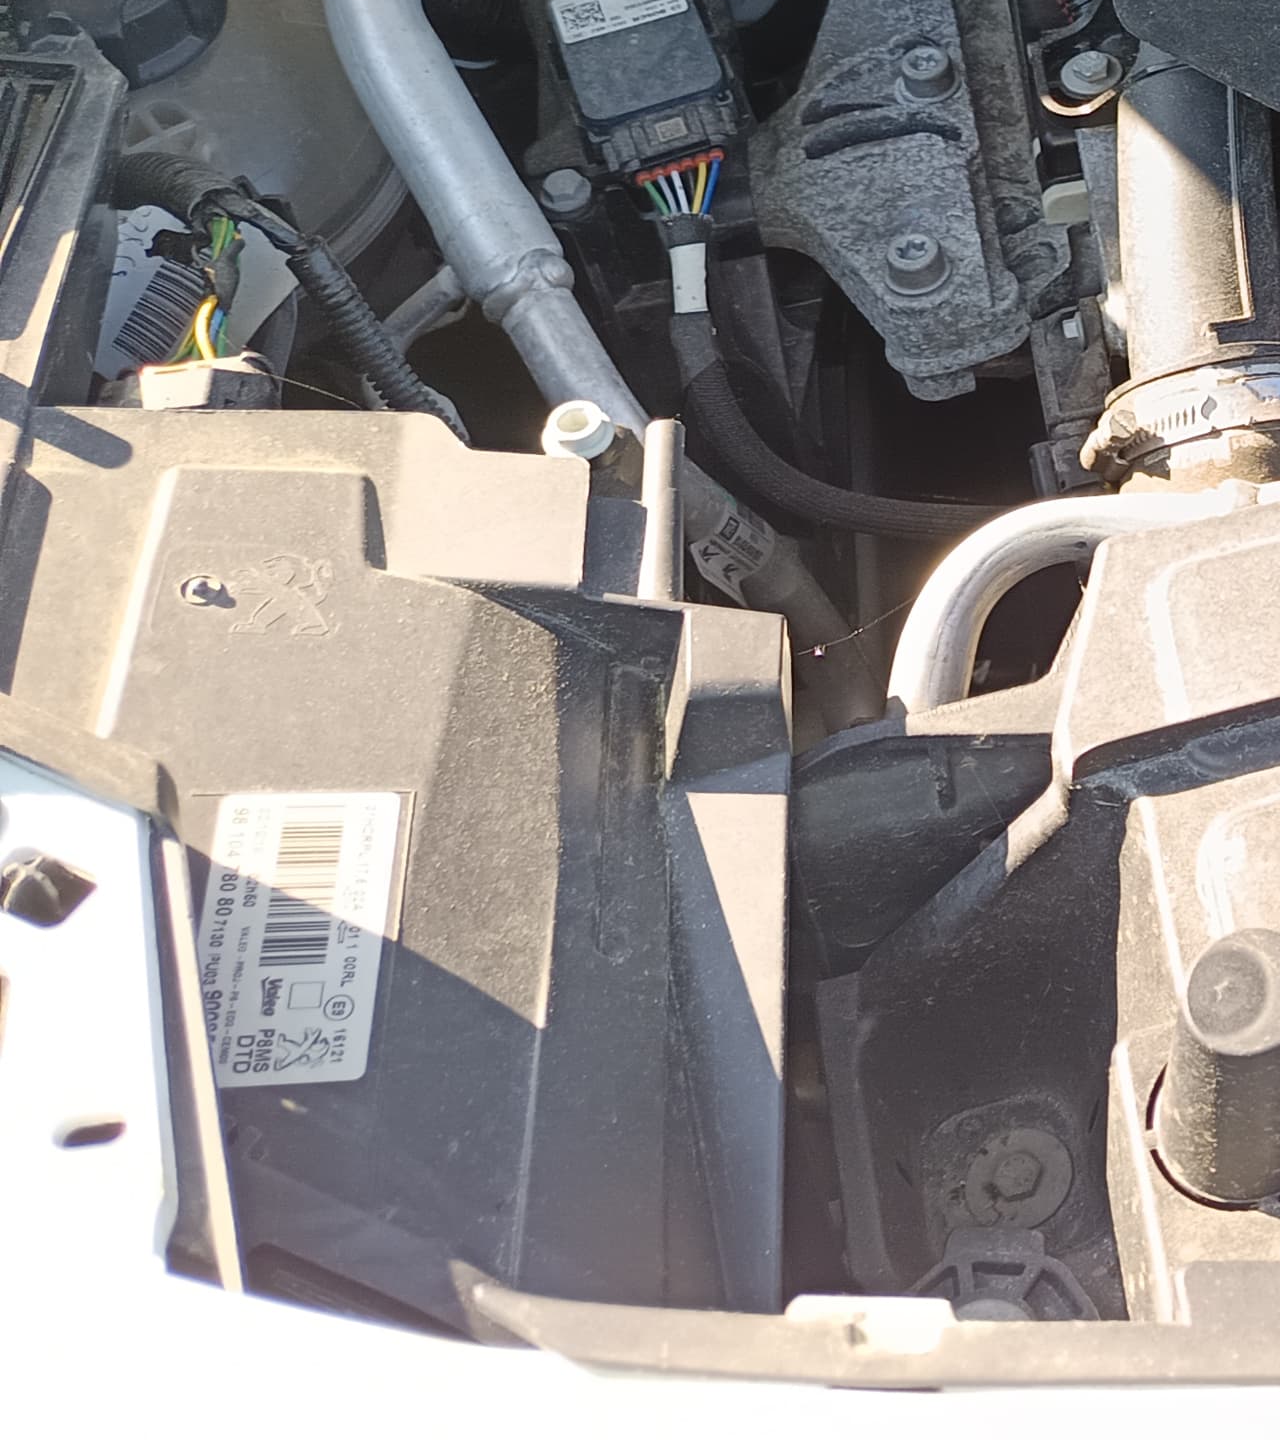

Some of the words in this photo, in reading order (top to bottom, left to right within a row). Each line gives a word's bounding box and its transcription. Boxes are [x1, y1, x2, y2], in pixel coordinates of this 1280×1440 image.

[262, 977, 284, 1017] Valeo
[232, 1034, 256, 1074] DTD
[252, 1028, 276, 1073] P8MS
